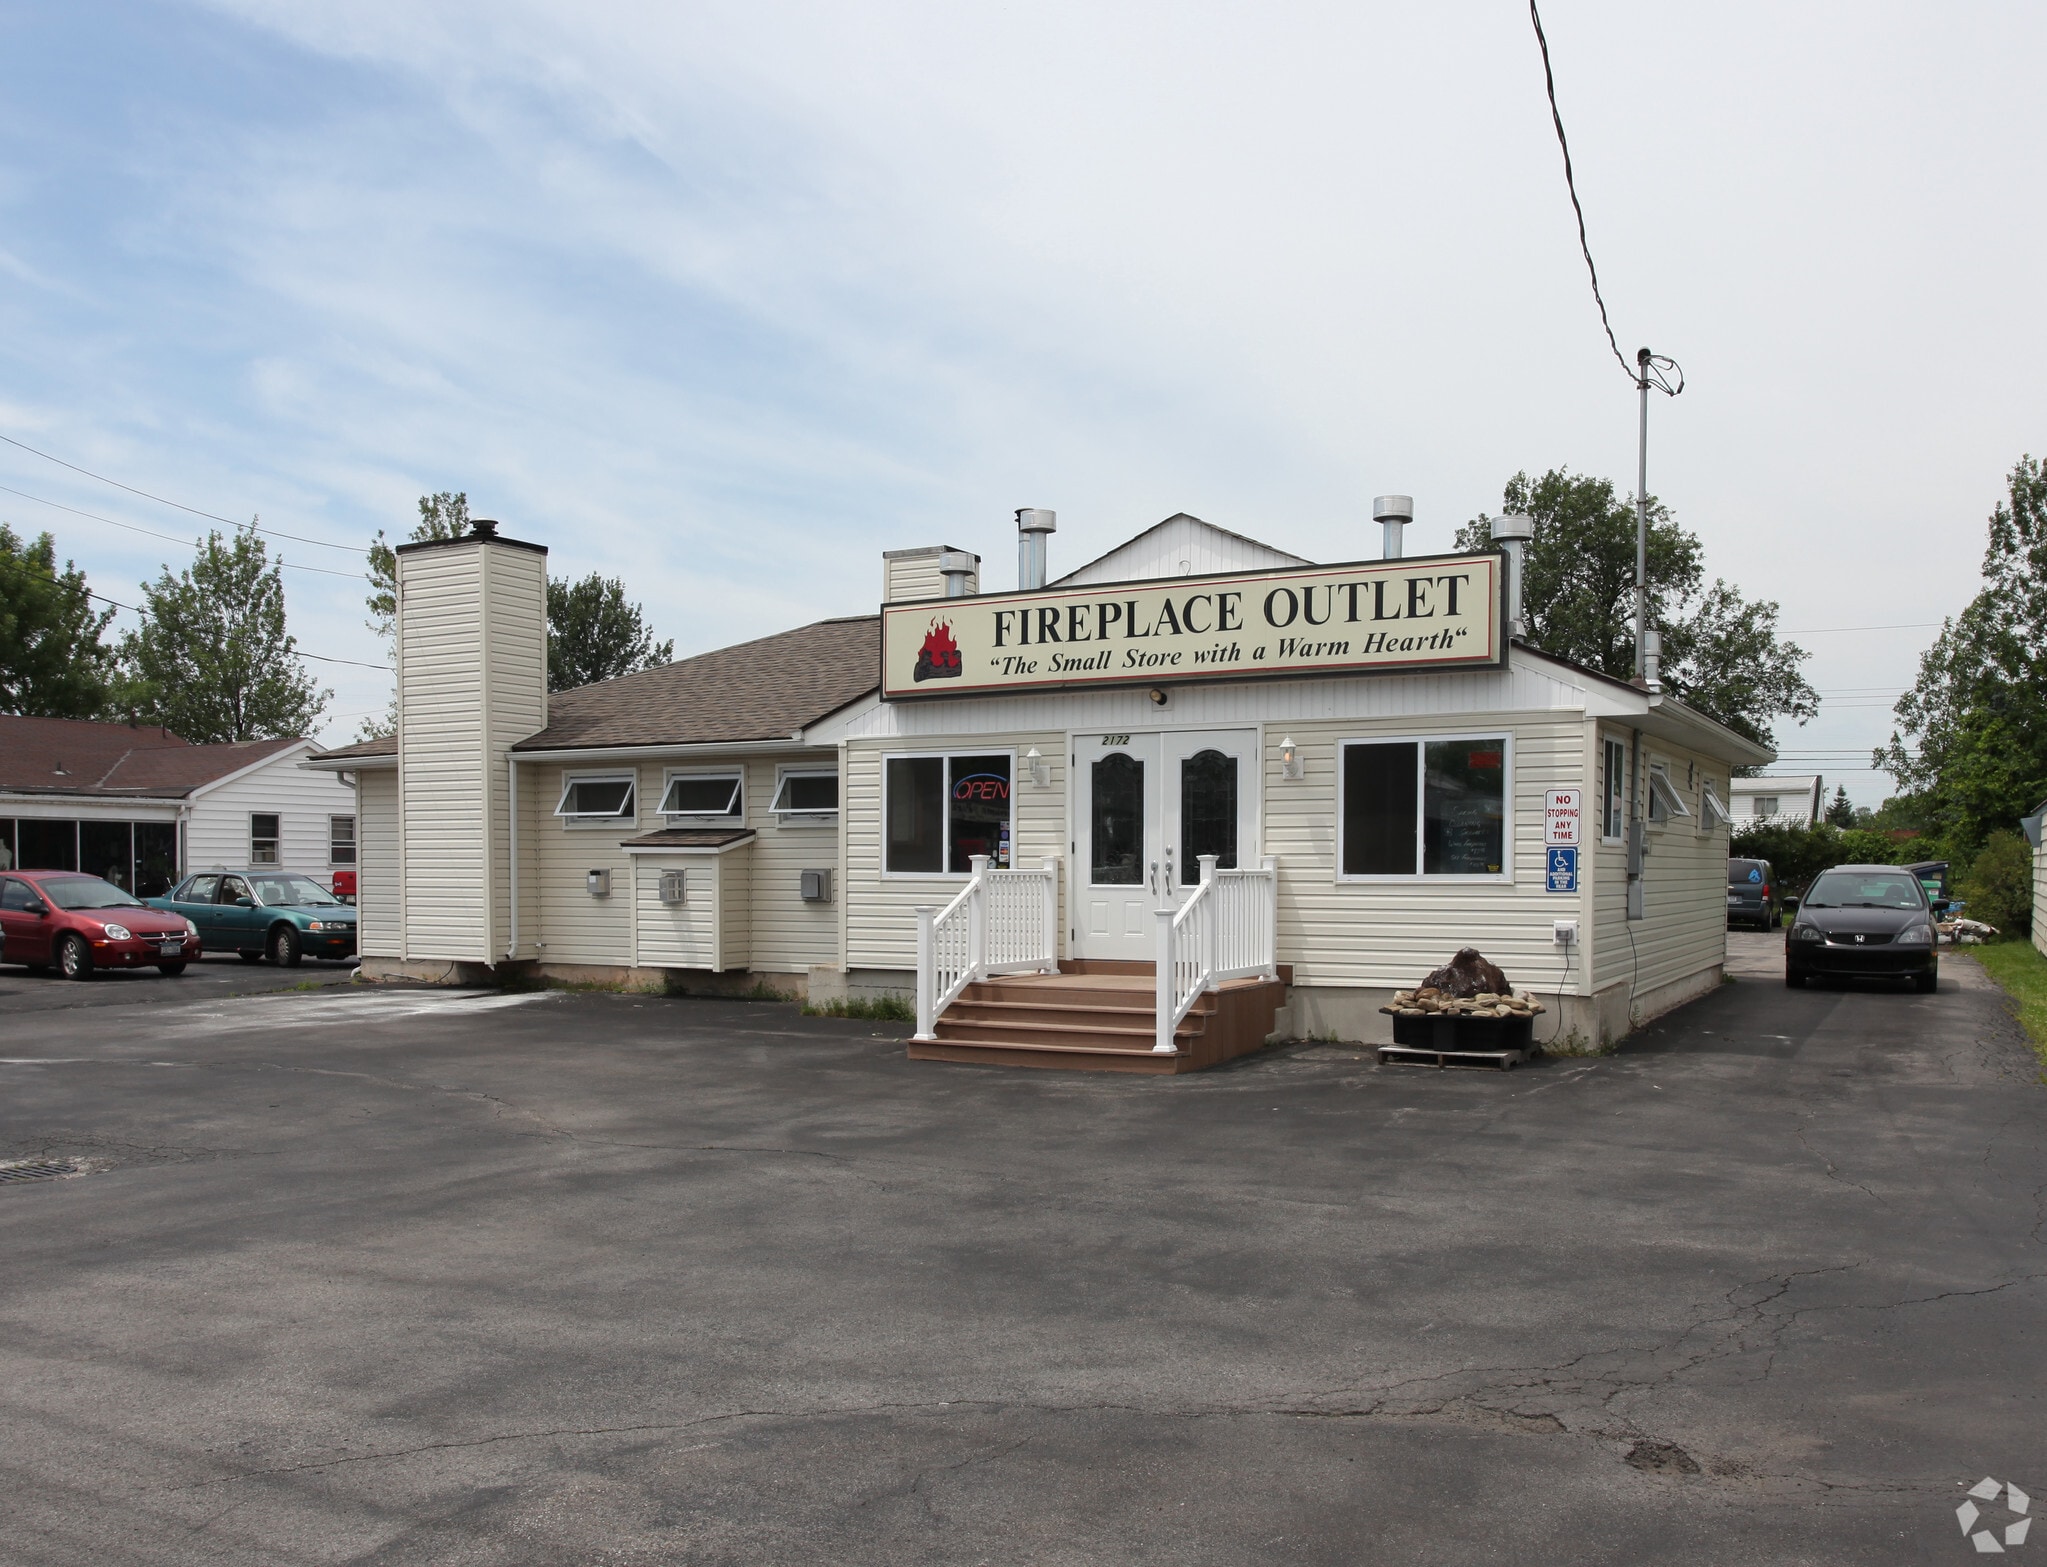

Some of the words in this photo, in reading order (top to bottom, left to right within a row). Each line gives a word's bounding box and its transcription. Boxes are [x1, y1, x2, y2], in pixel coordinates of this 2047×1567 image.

[992, 592, 1244, 648] FIREPLACE
[1263, 574, 1470, 628] OUTLET
[1047, 650, 1112, 673] Small
[1122, 648, 1182, 669] Store
[1193, 642, 1241, 664] with
[1252, 646, 1266, 660] a
[1278, 637, 1350, 659] Warm
[1102, 735, 1130, 745] 2172
[956, 781, 1010, 799] OPEN
[1556, 795, 1571, 804] NO
[1547, 808, 1578, 818] STOPPING
[1555, 821, 1571, 829] ANY
[1553, 831, 1573, 839] TIME
